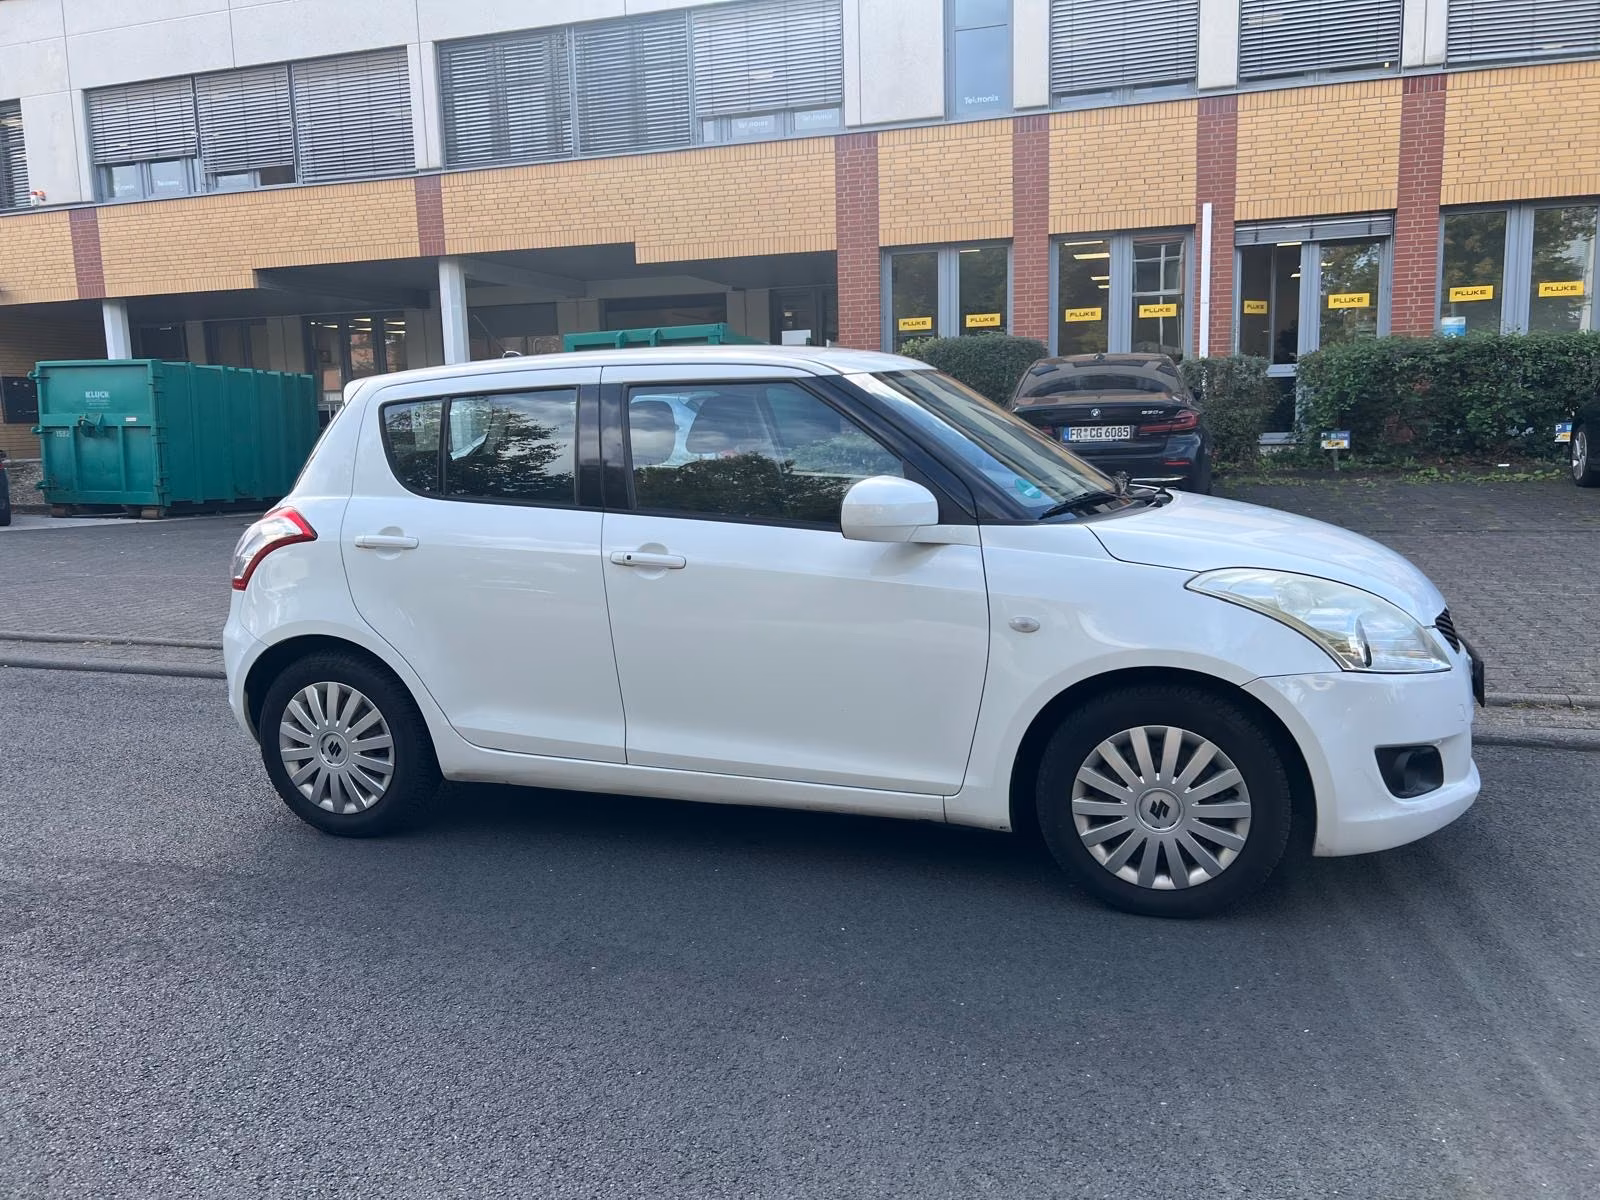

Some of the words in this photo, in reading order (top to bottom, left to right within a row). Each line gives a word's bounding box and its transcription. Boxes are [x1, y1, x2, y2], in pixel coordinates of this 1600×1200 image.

[1070, 428, 1082, 438] FR
[1089, 427, 1102, 438] CG
[1104, 426, 1129, 437] 6085
